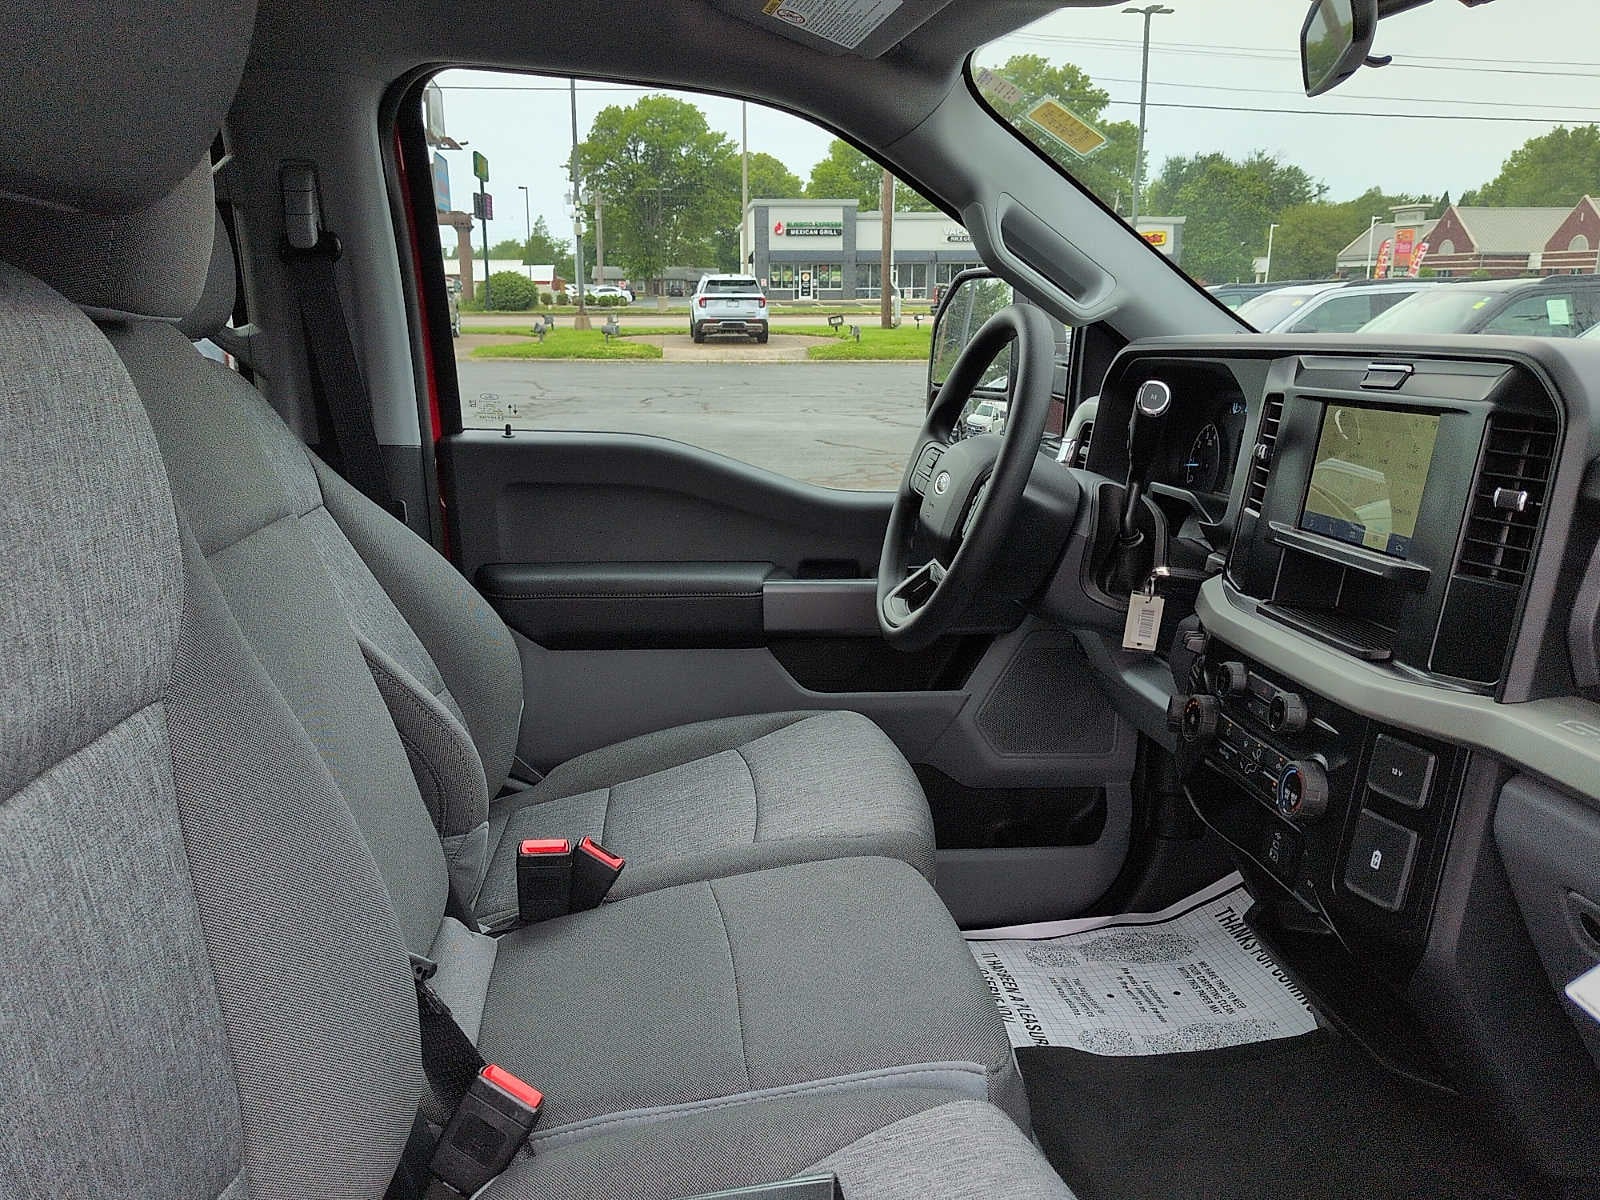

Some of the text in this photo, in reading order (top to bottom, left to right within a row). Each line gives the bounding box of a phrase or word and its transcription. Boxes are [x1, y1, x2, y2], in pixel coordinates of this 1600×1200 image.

[790, 228, 837, 236] MEXICAN GRILL
[1213, 905, 1260, 948] THANKS
